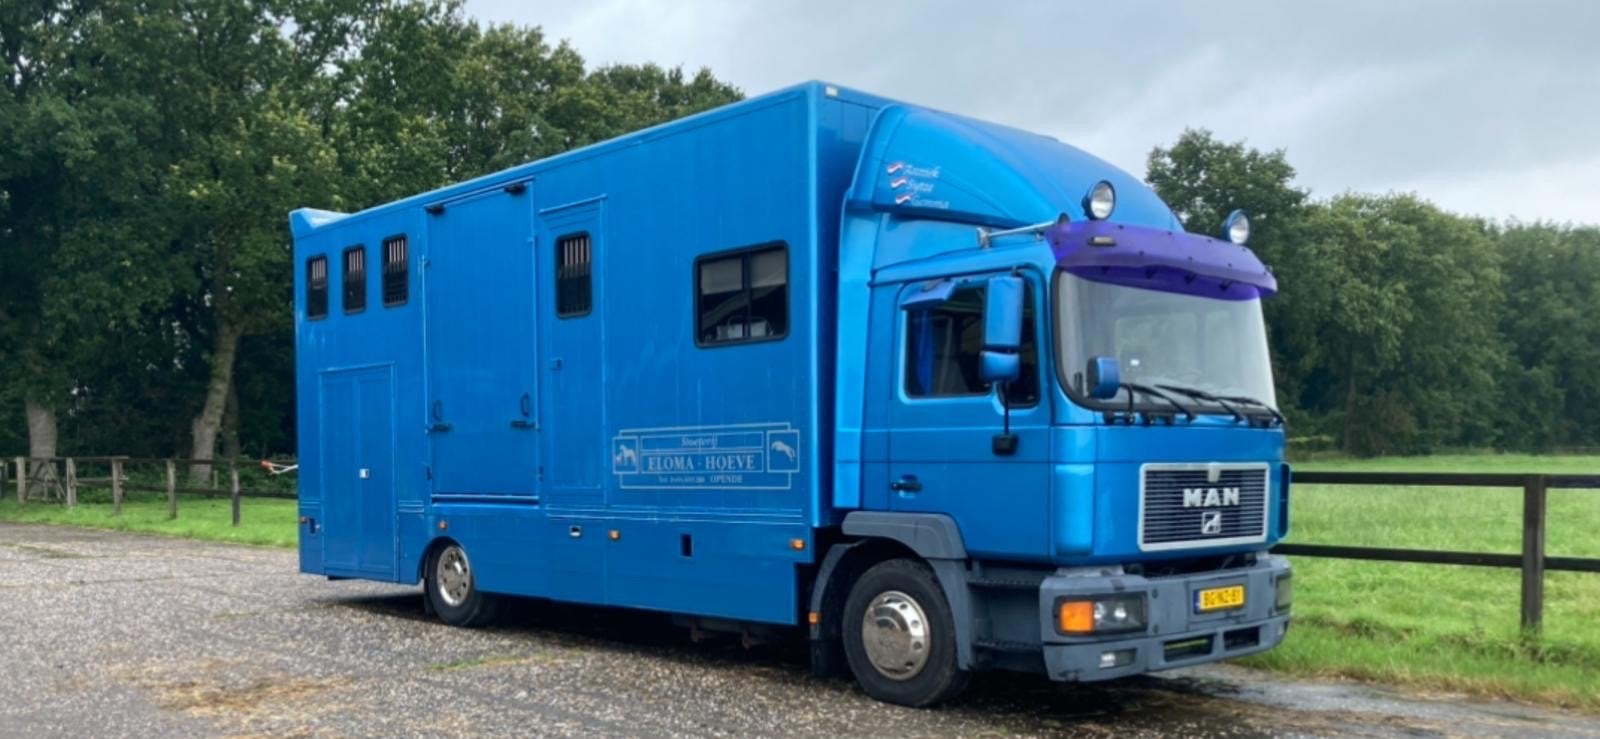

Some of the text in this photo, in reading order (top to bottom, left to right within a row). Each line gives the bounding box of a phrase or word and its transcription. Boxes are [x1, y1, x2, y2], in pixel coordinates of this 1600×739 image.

[648, 456, 694, 470] ELOMA
[705, 455, 755, 470] HOEVE
[1183, 487, 1239, 507] MAN
